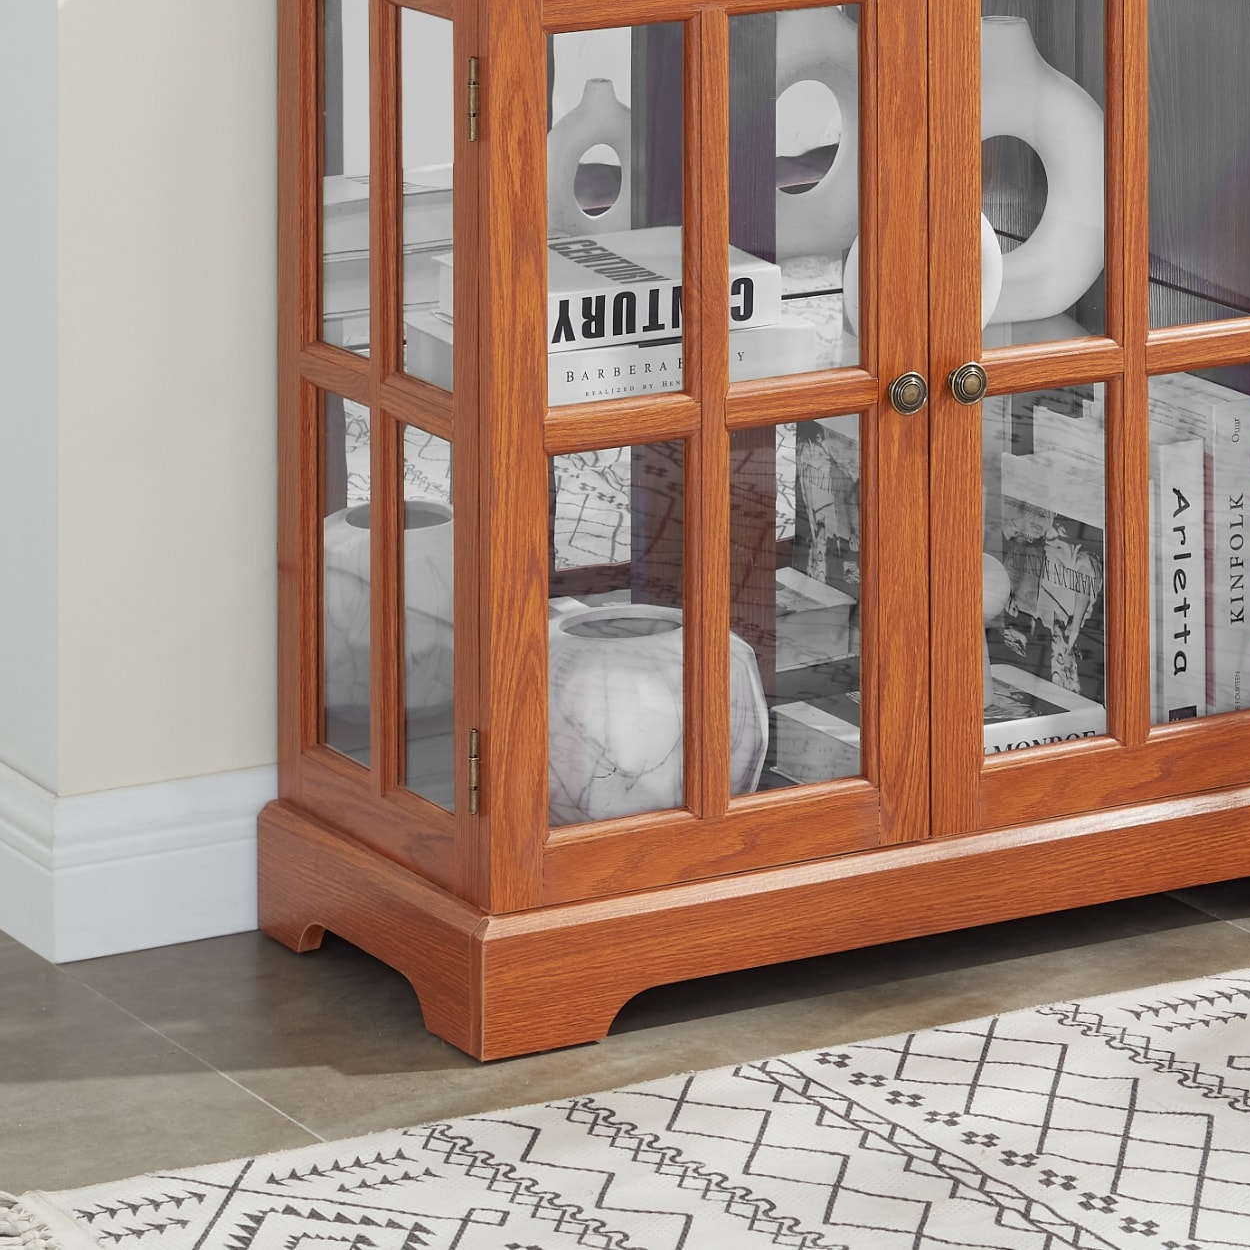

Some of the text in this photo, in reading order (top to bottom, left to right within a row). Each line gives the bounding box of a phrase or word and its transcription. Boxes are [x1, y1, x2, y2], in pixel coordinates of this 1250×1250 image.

[548, 239, 672, 285] CENTURY
[566, 361, 668, 383] BARBERA
[585, 385, 635, 398] REALIZED
[642, 383, 654, 391] BY
[1231, 417, 1240, 443] Ouur
[1229, 493, 1245, 624] KINFOLK
[1053, 562, 1097, 599] MARILYN
[1172, 487, 1192, 676] Arletta
